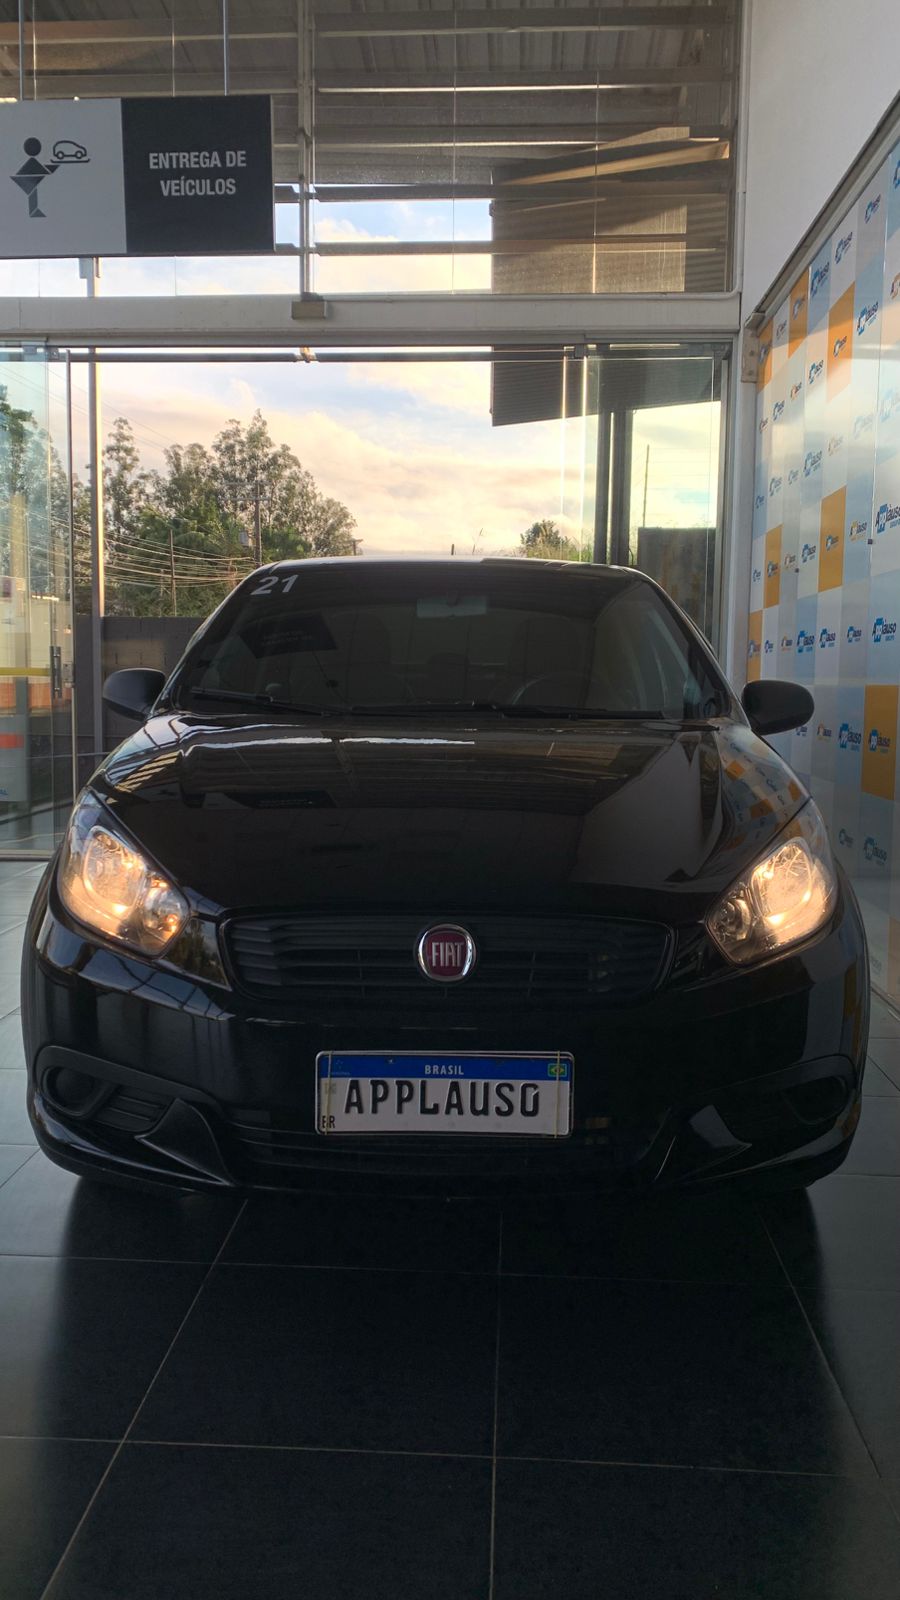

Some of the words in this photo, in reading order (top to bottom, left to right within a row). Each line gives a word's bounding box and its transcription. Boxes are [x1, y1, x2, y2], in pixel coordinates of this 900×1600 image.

[149, 151, 222, 169] ENTREGA
[225, 150, 247, 167] DE
[160, 176, 236, 197] VEÍCULOS
[250, 575, 299, 595] 21
[432, 941, 464, 967] FIAT
[424, 1064, 464, 1075] BRASIL
[344, 1079, 539, 1117] APPLAUSO
